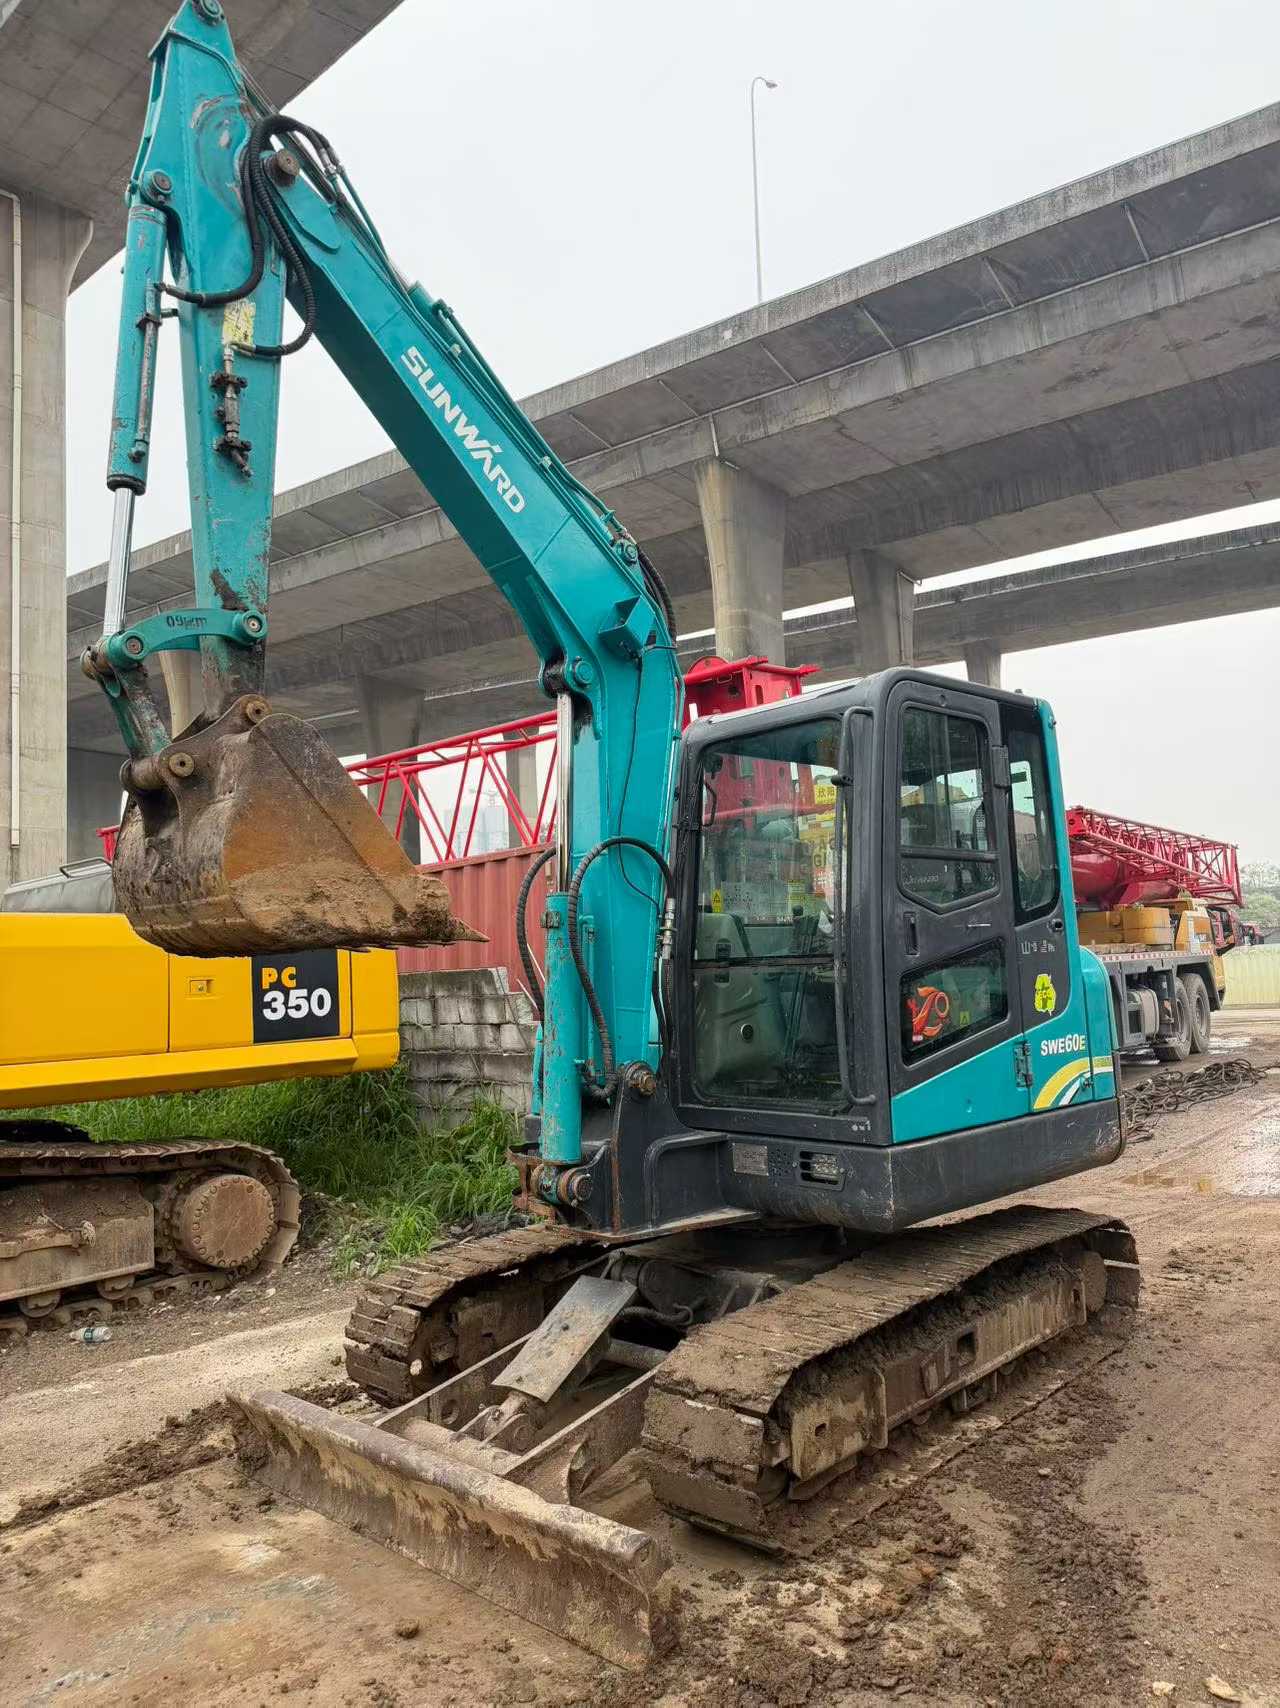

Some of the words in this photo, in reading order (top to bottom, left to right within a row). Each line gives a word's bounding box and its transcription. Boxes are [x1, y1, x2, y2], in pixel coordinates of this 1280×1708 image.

[401, 346, 526, 513] SUNWARD
[262, 966, 297, 989] PC
[262, 987, 332, 1021] 350
[1040, 1033, 1086, 1057] SWE60E
